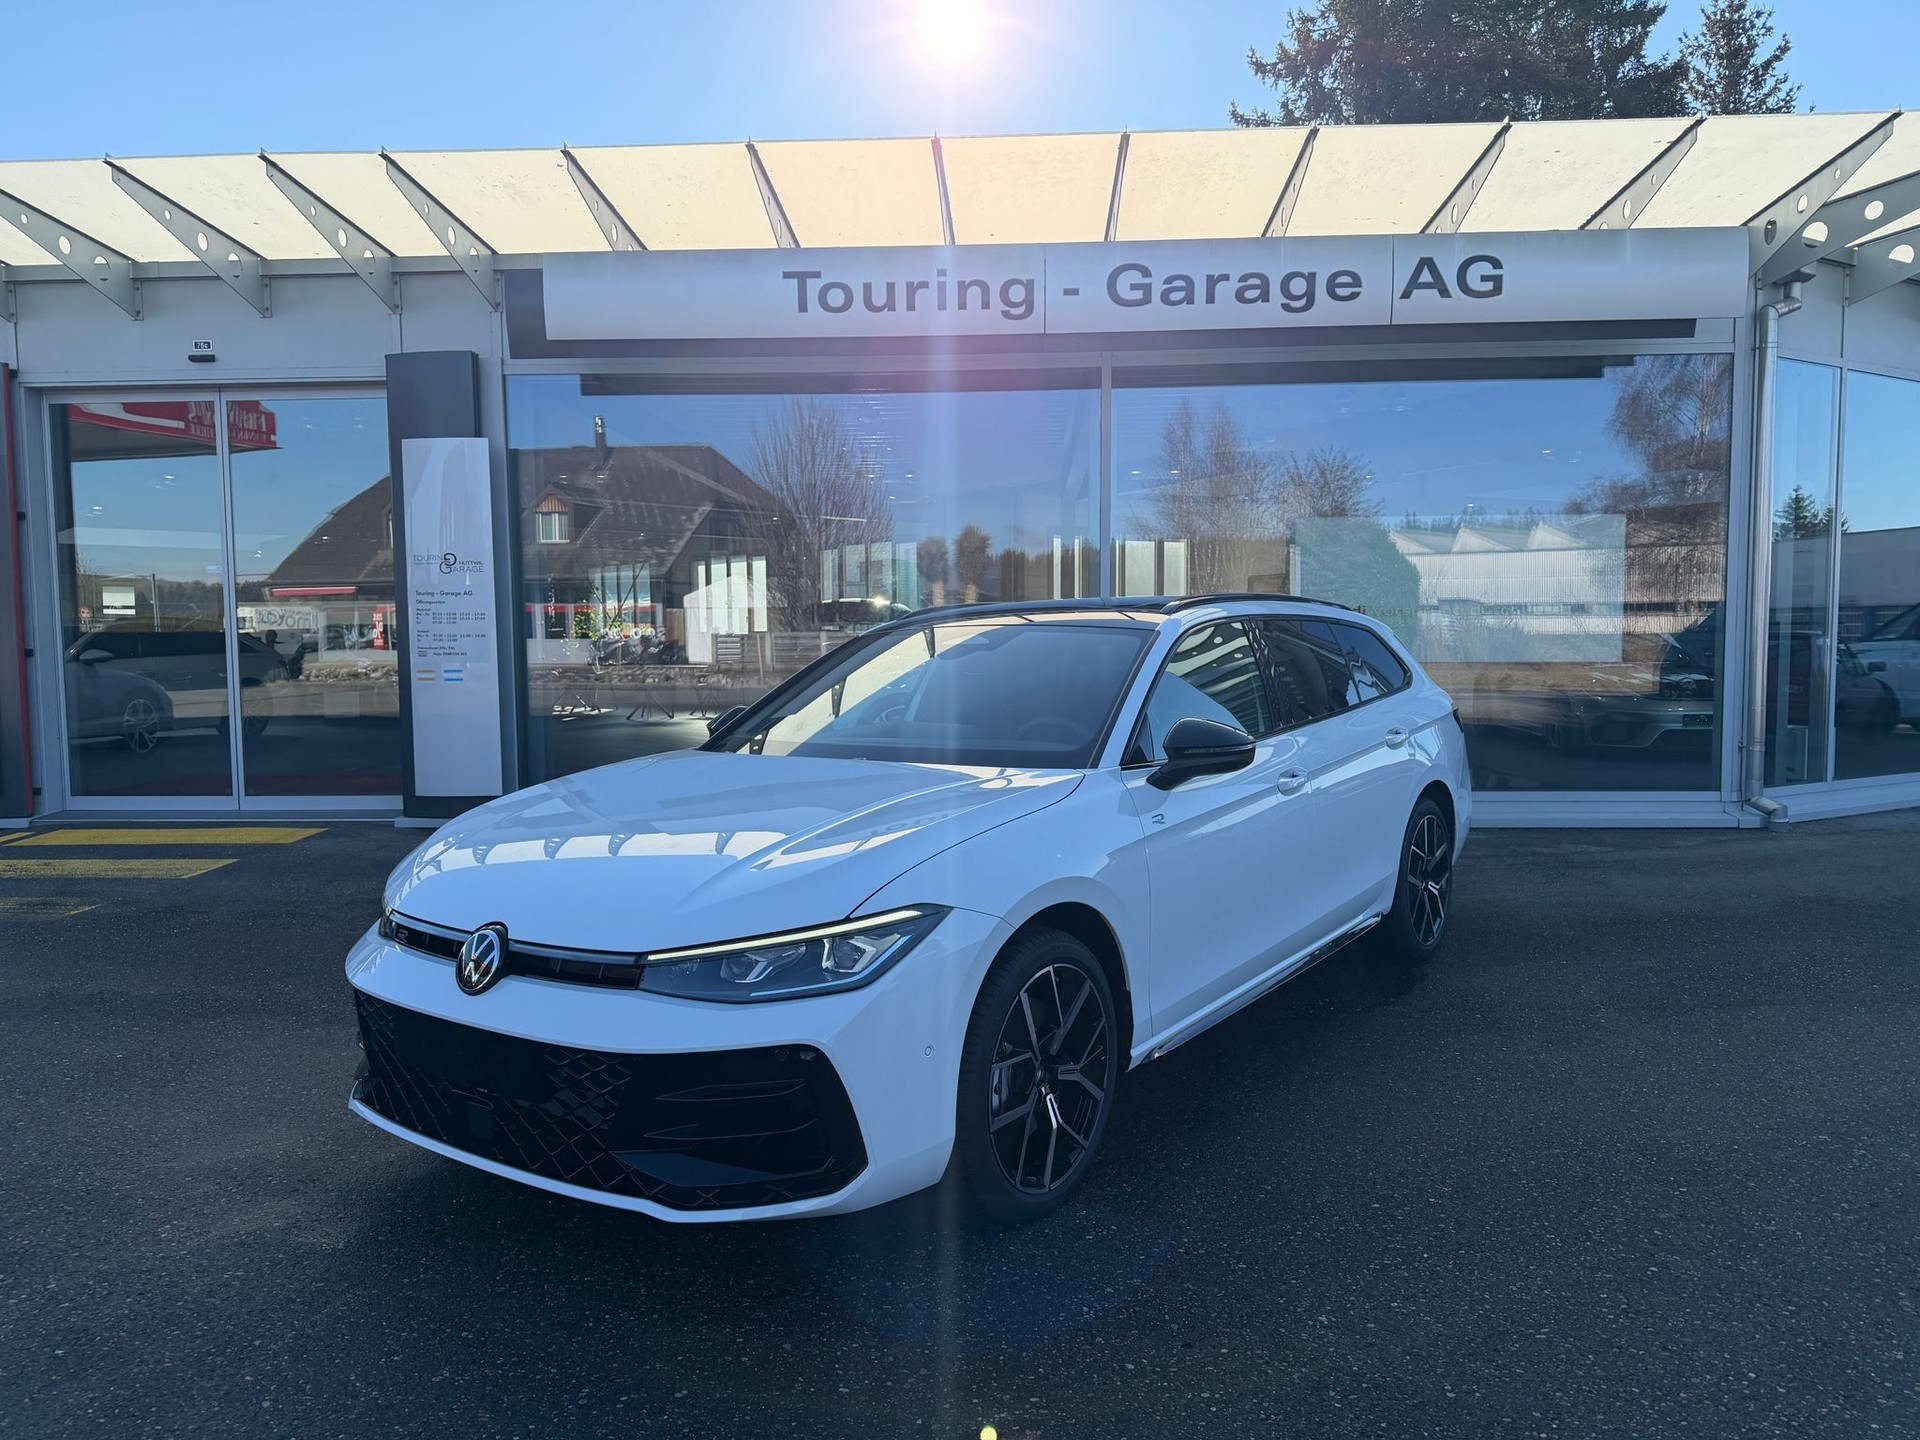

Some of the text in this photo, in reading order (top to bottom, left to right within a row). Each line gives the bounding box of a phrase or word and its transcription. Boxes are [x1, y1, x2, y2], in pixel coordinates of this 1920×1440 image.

[782, 254, 1505, 321] Touring - Garage AG
[439, 561, 485, 574] GARAGE
